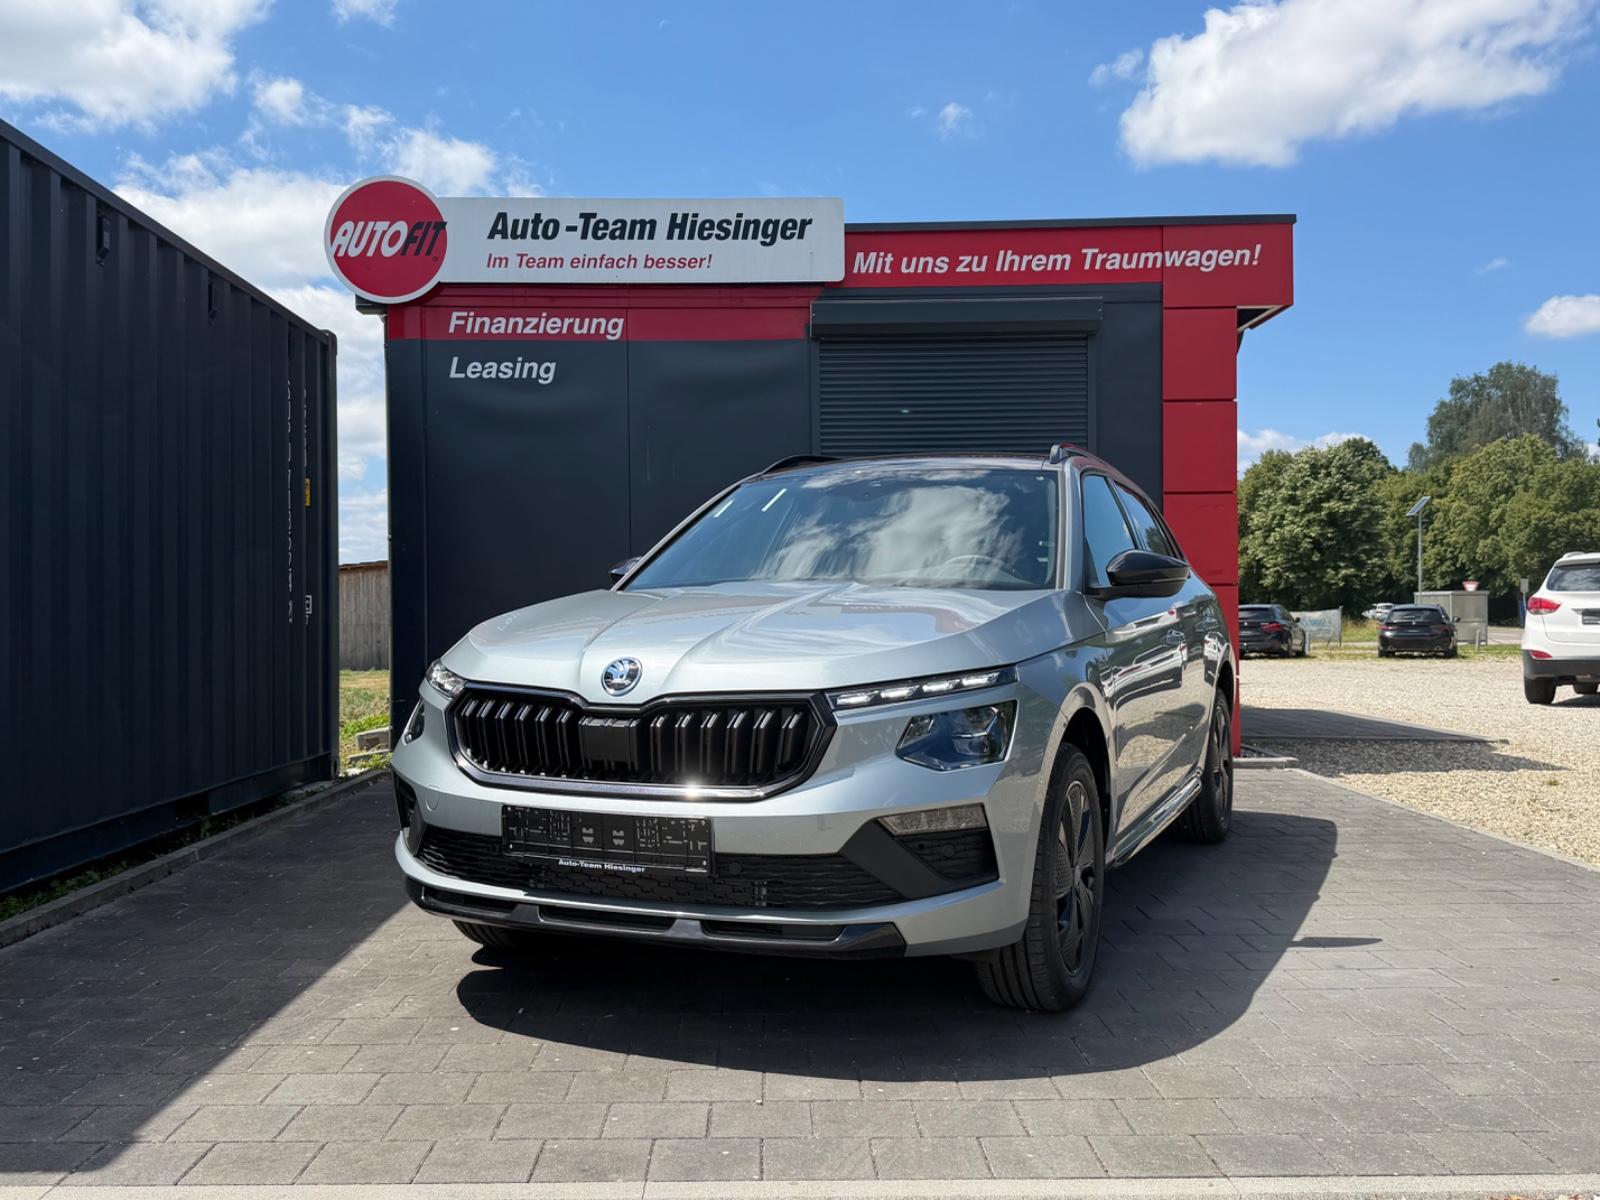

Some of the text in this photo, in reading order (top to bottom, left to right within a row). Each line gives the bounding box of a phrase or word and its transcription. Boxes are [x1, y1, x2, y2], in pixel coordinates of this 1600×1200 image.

[331, 220, 447, 257] AUTOFIT
[666, 212, 813, 248] Hiesinger
[487, 253, 712, 269] Im Team einfach besser!
[853, 244, 1262, 274] Mit uns zu Ihrem Traumwagen!
[449, 312, 624, 341] Finanzierung
[450, 356, 556, 386] Leasing
[559, 858, 645, 873] Auto-Team Hiesinger
